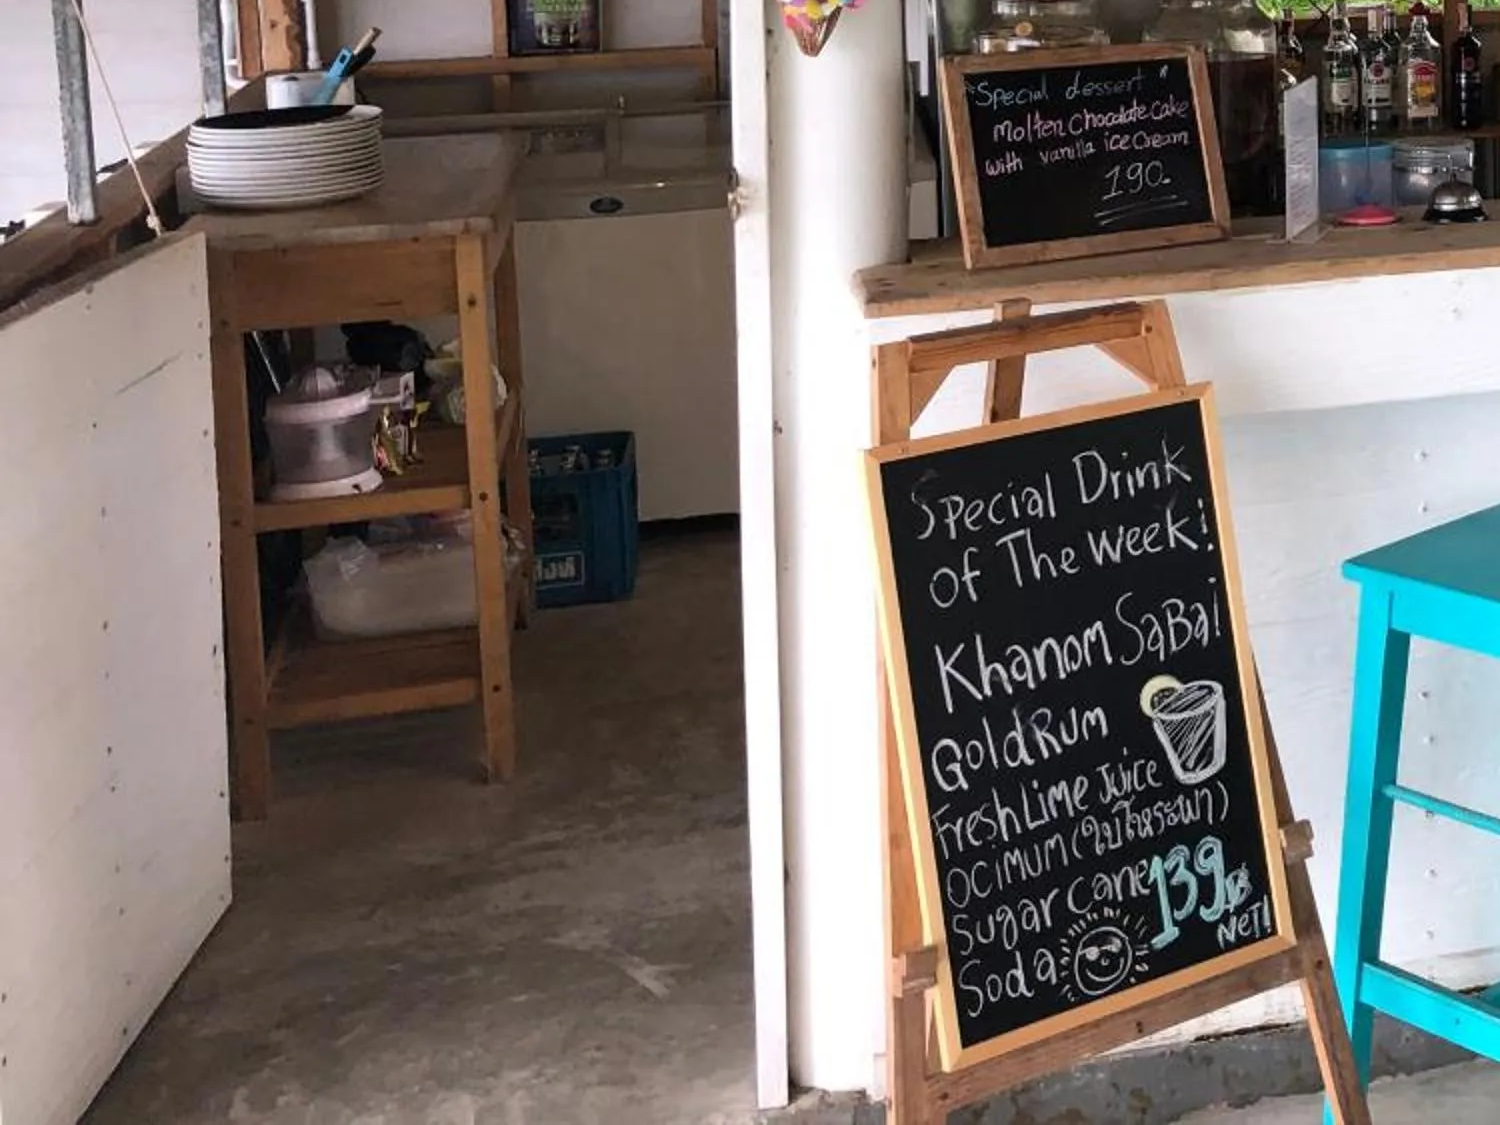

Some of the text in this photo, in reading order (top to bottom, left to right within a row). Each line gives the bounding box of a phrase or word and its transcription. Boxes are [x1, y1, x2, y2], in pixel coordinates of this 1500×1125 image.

[975, 67, 1144, 110] Special dessert
[1073, 437, 1192, 505] Drink
[996, 528, 1081, 587] The
[957, 947, 1057, 1018] Soda
